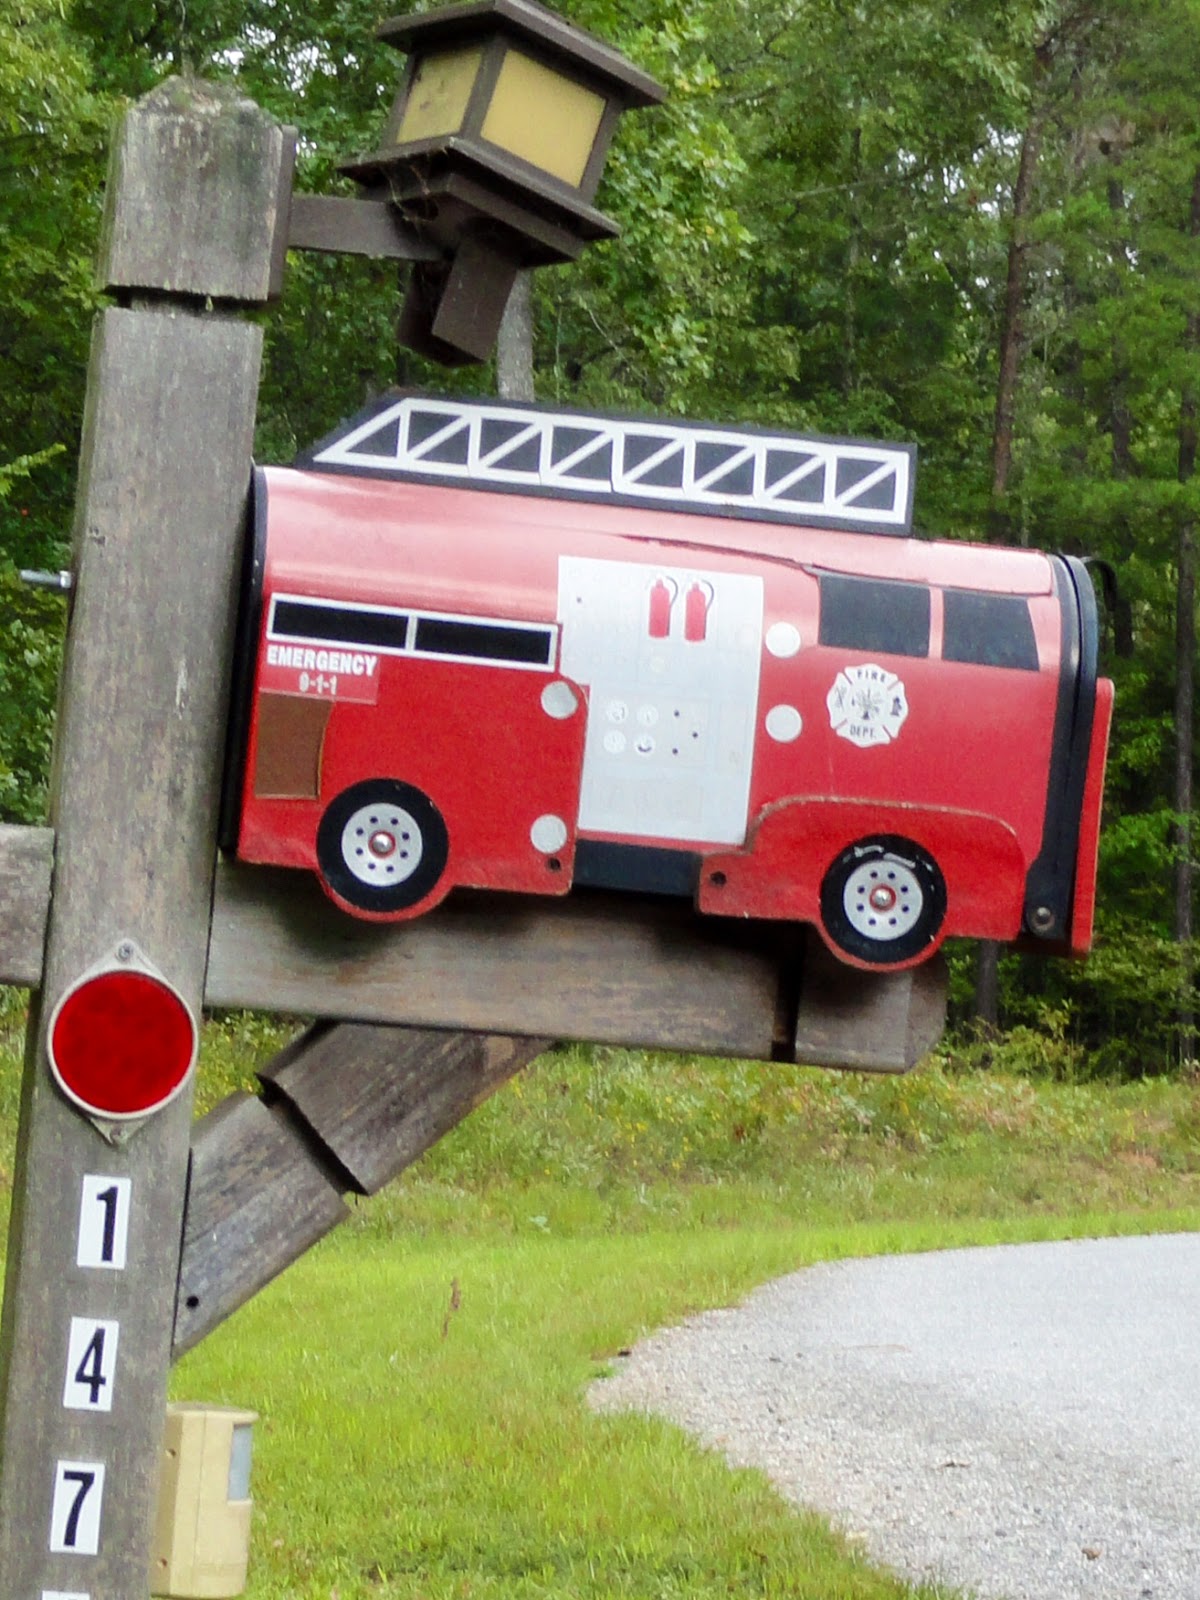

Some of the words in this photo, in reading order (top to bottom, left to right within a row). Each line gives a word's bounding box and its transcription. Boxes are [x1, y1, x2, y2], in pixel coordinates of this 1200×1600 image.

[267, 644, 377, 677] EMERGENCY
[857, 668, 886, 683] FIRE
[96, 1185, 118, 1262] 1
[74, 1327, 106, 1404] 4
[62, 1470, 95, 1546] 7
